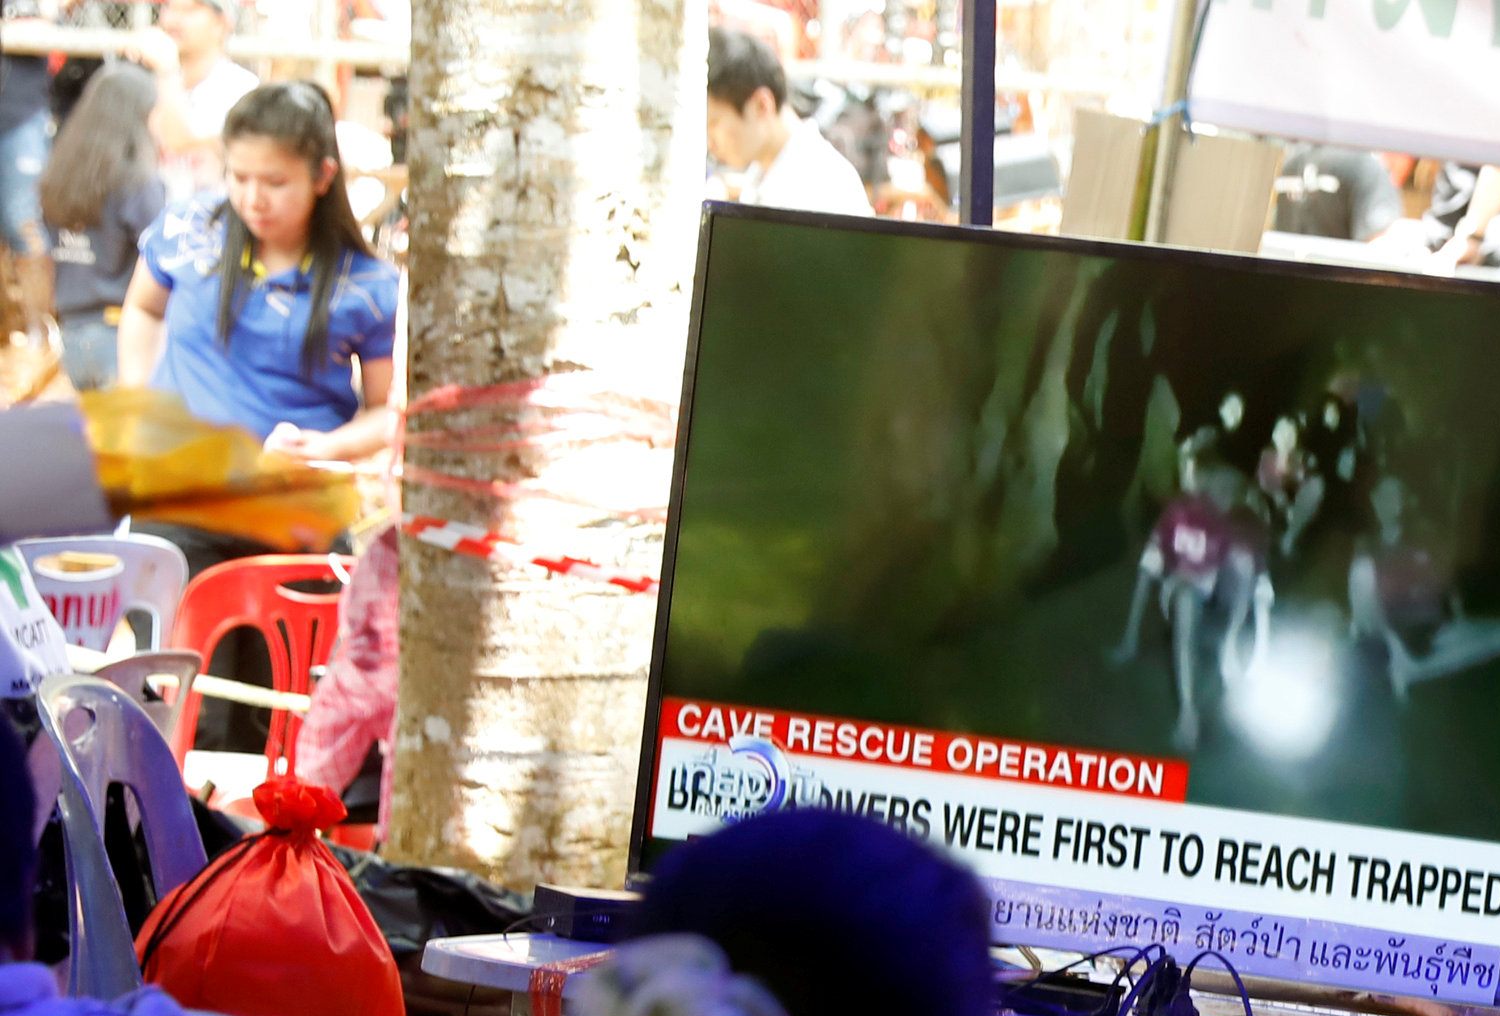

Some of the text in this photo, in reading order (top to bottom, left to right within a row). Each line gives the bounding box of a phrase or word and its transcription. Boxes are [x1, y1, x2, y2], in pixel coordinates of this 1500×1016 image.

[677, 703, 1164, 796] CAVE RESCUE OPERATION
[944, 802, 1044, 857] WERE
[1052, 817, 1150, 872] FIRST
[1159, 830, 1204, 878] TO
[1214, 838, 1336, 895] REACH
[1194, 911, 1302, 956] สัตว์ป่า
[1309, 937, 1495, 996] และพันธุ์พืช
